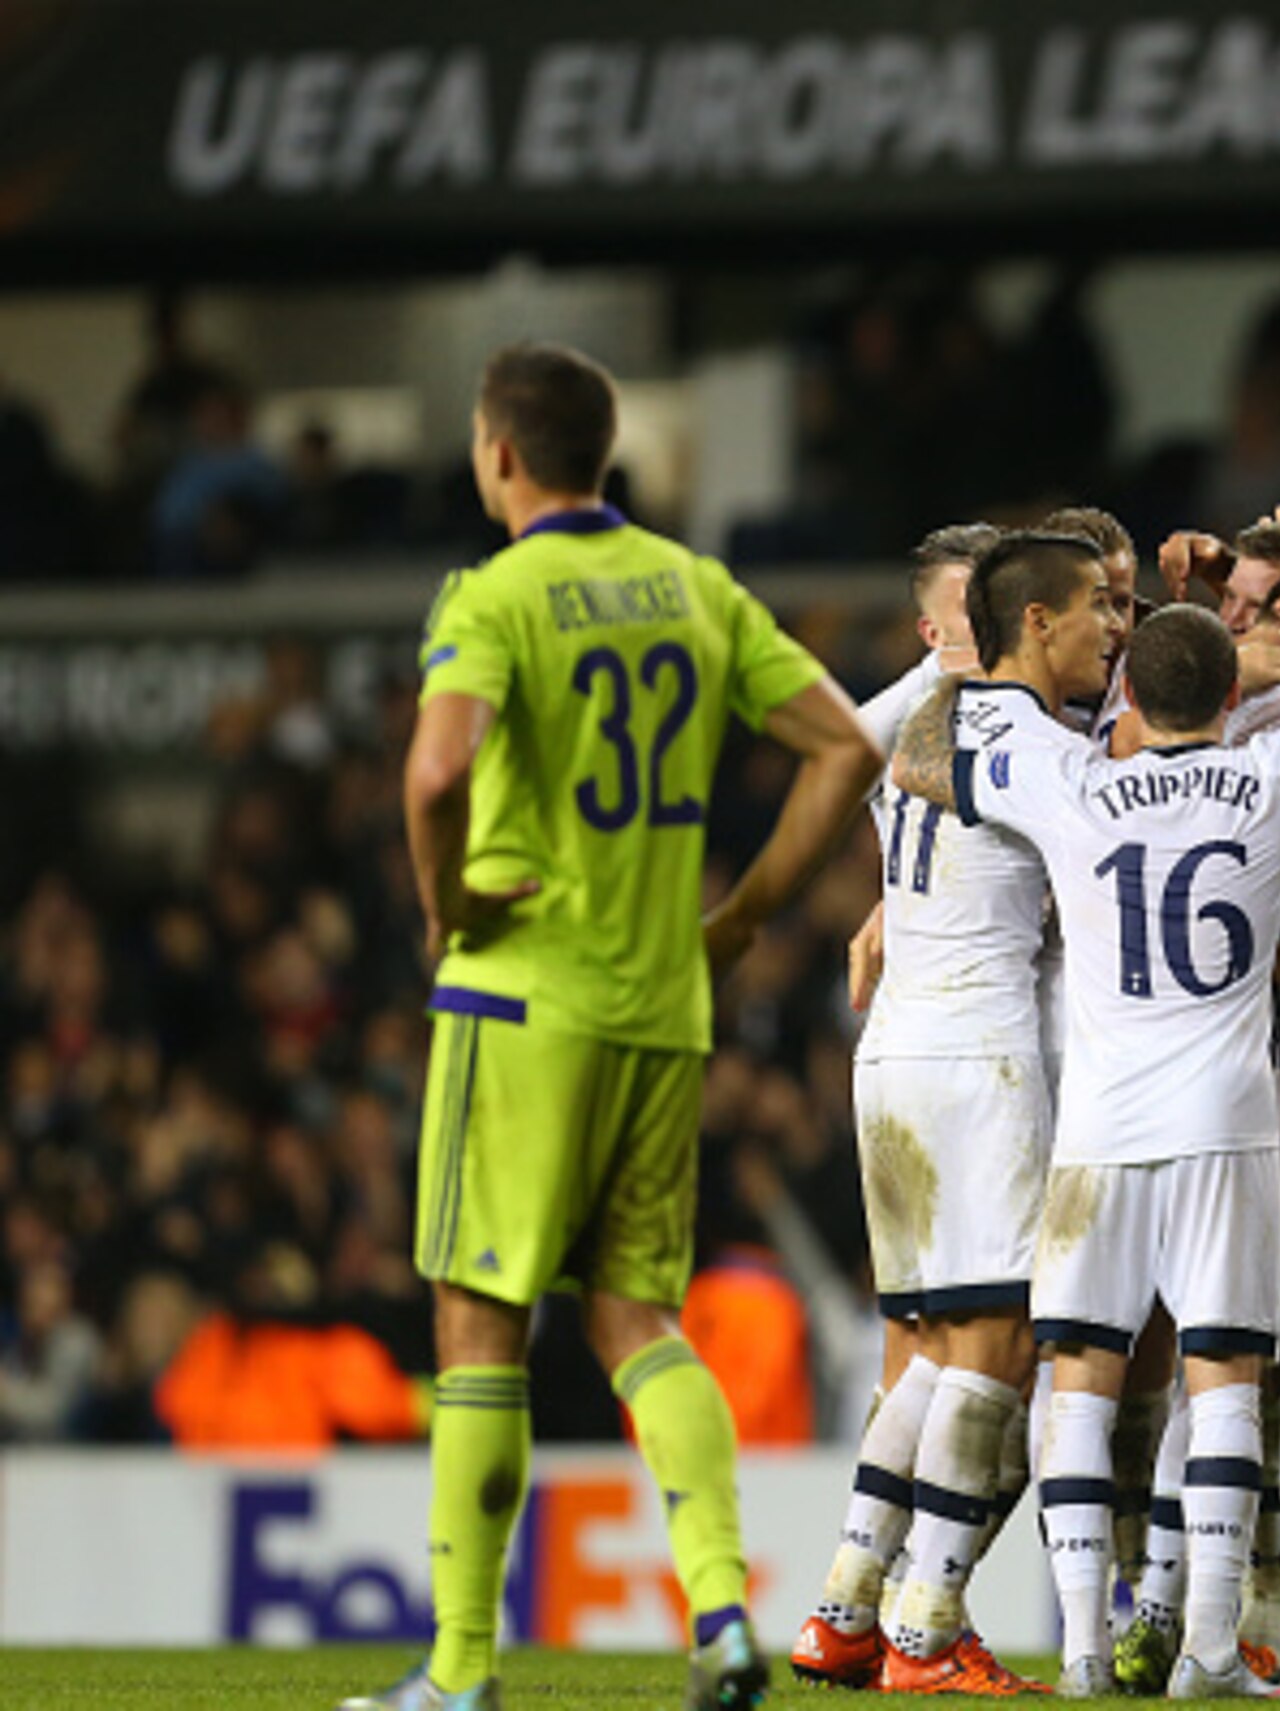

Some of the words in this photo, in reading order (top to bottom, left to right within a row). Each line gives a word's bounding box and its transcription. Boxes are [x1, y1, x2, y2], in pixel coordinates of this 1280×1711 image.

[167, 46, 490, 190] UEFA
[509, 36, 996, 186] EUROPA
[572, 641, 703, 832] 32
[1091, 766, 1260, 820] TRIPPIER
[1094, 840, 1255, 999] 16
